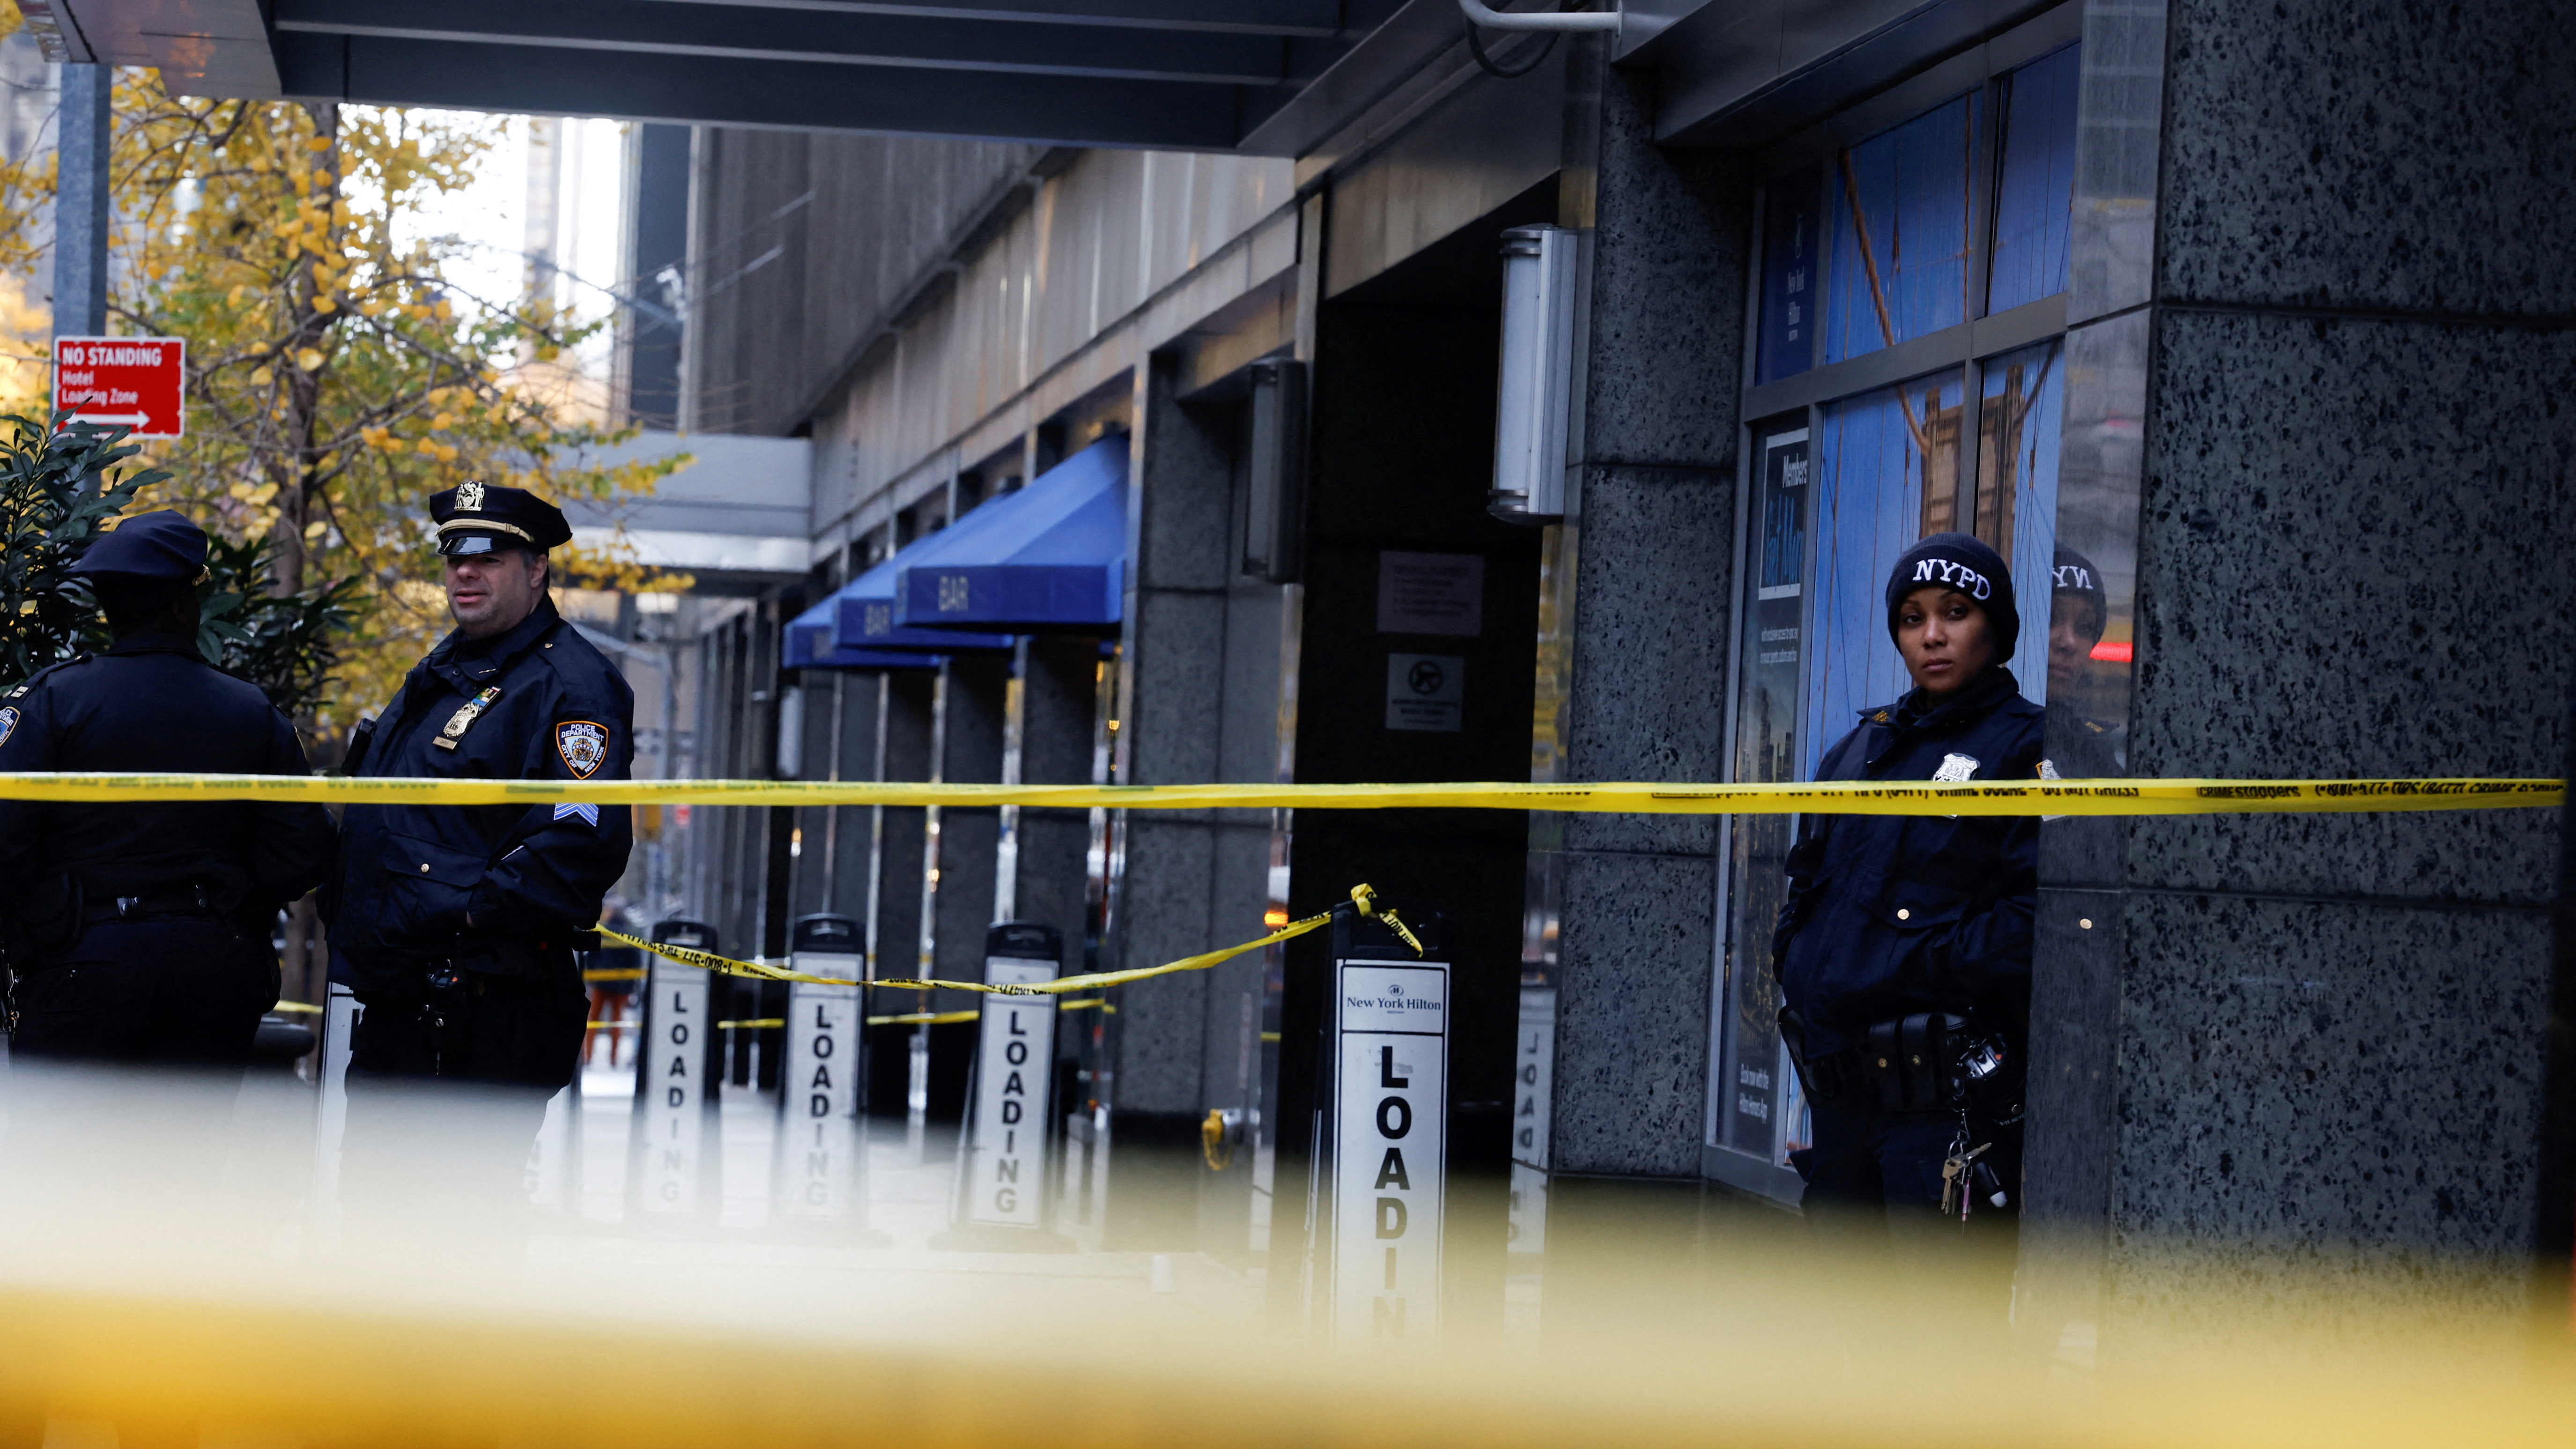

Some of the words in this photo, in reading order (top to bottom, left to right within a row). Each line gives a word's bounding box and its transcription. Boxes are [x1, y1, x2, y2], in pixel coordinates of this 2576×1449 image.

[62, 347, 85, 366] NO
[88, 347, 162, 366] STANDING
[62, 370, 94, 386] Hotel
[62, 389, 107, 407] Loading
[110, 388, 138, 404] Zone
[1783, 453, 1807, 488] Members
[938, 576, 968, 611] BAR
[1913, 559, 1991, 600] NYPD
[561, 730, 604, 742] DEPARTMENT
[561, 744, 570, 758] CITY
[569, 759, 577, 768] OF
[584, 761, 596, 773] NEW
[594, 746, 605, 761] YORK
[1347, 997, 1375, 1007] New
[1377, 998, 1404, 1008] York
[1407, 998, 1441, 1010] Hilton
[660, 992, 688, 1202] LOADING
[806, 1005, 834, 1207] LOADING
[995, 1010, 1029, 1214] LOADING
[1372, 1045, 1413, 1338] LOADIN
